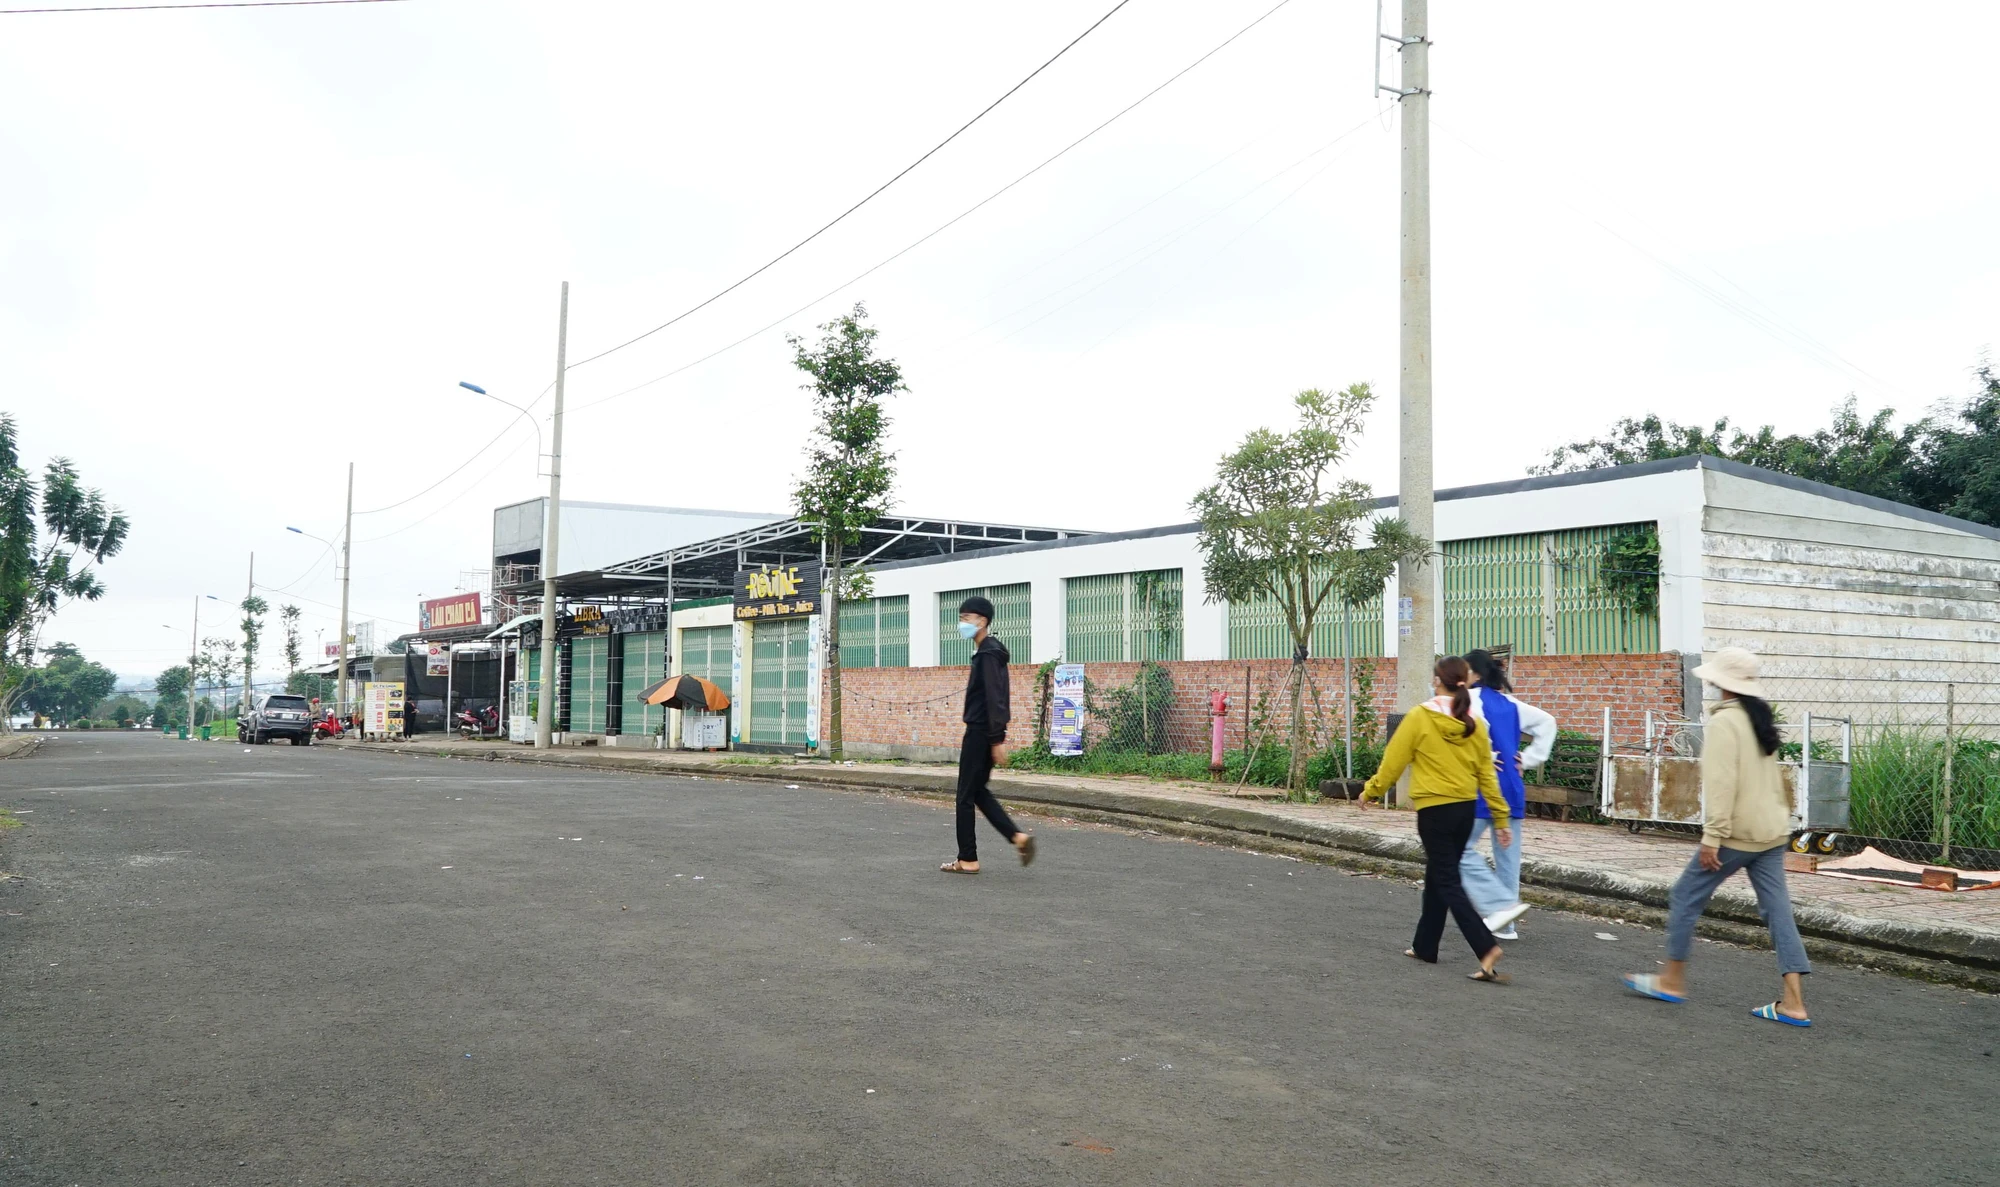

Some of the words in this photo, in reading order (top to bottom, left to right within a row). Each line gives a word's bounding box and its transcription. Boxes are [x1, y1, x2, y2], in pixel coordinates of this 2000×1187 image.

[574, 605, 602, 623] LIBRA
[736, 606, 759, 618] Coffee
[762, 603, 777, 616] Milk
[776, 602, 790, 614] Tea
[794, 600, 814, 613] Juice
